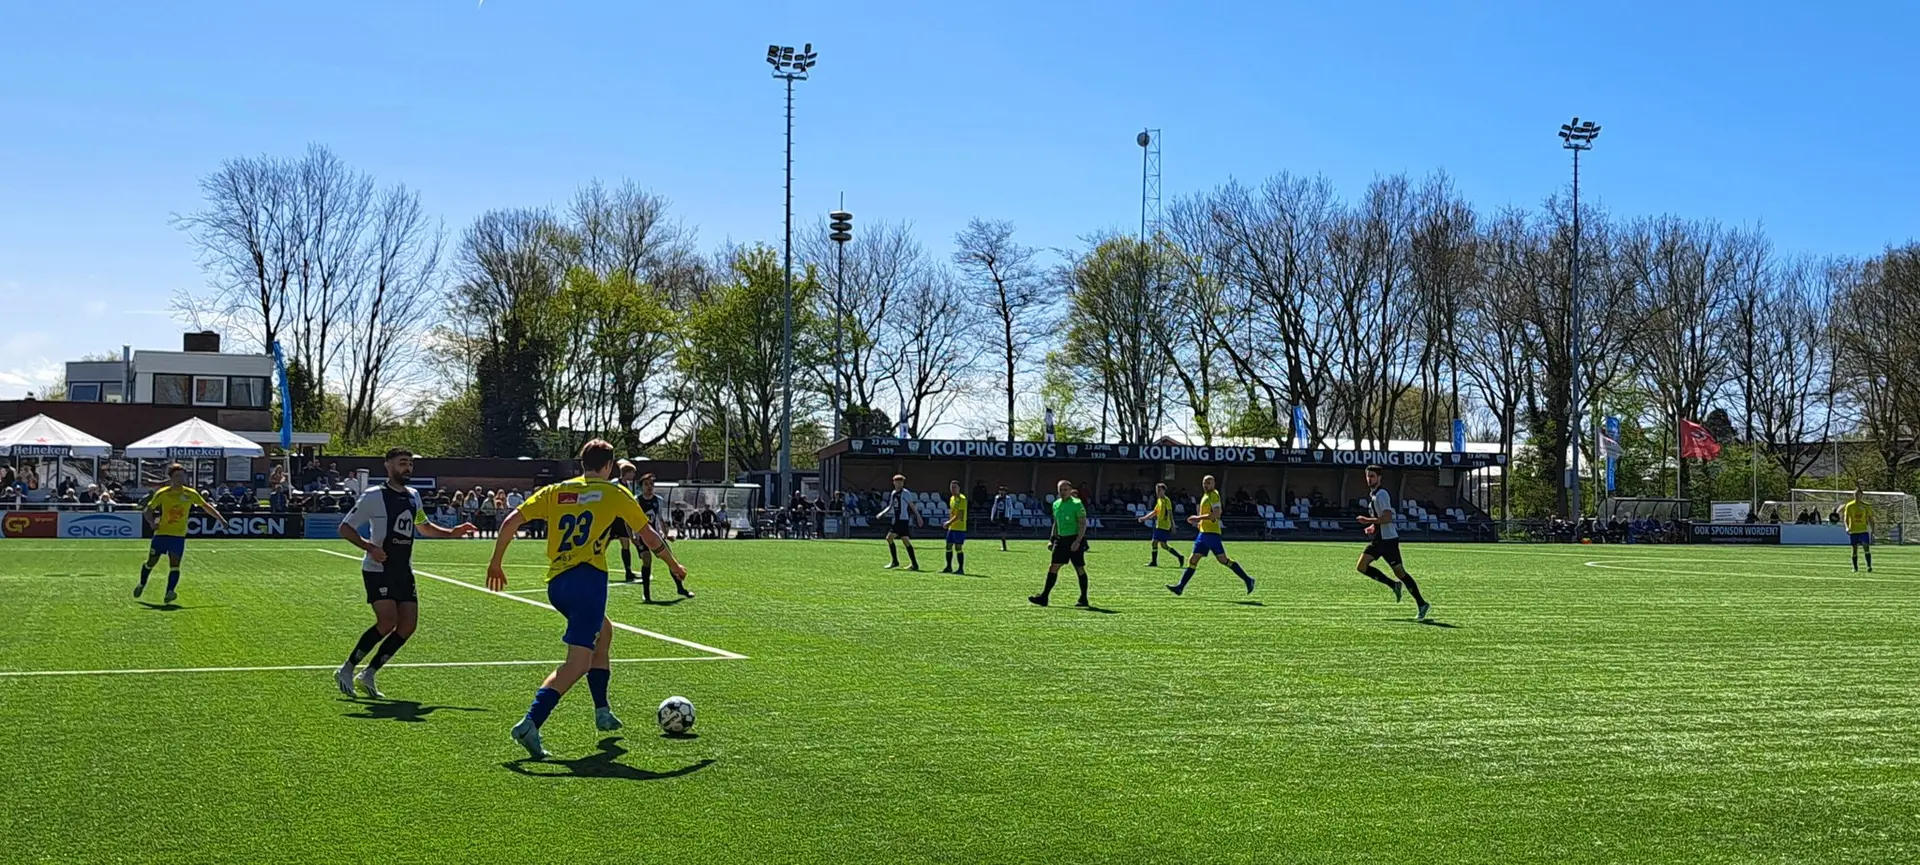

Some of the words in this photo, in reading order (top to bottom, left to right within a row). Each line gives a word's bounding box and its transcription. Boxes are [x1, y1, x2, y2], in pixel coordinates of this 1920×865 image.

[13, 444, 70, 455] Heineken
[169, 446, 222, 457] Heineken
[878, 447, 895, 455] 1939
[930, 440, 1007, 456] KOLPING
[1012, 442, 1057, 457] BOYS
[1139, 445, 1209, 461] KOLPING
[1214, 447, 1256, 462] BOYS
[1332, 450, 1399, 465] KOLPING
[1403, 452, 1443, 466] BOYS
[557, 509, 594, 553] 23
[1694, 525, 1710, 535] OOK
[1711, 525, 1743, 536] SPONSOR
[1744, 525, 1779, 536] WORDEN?
